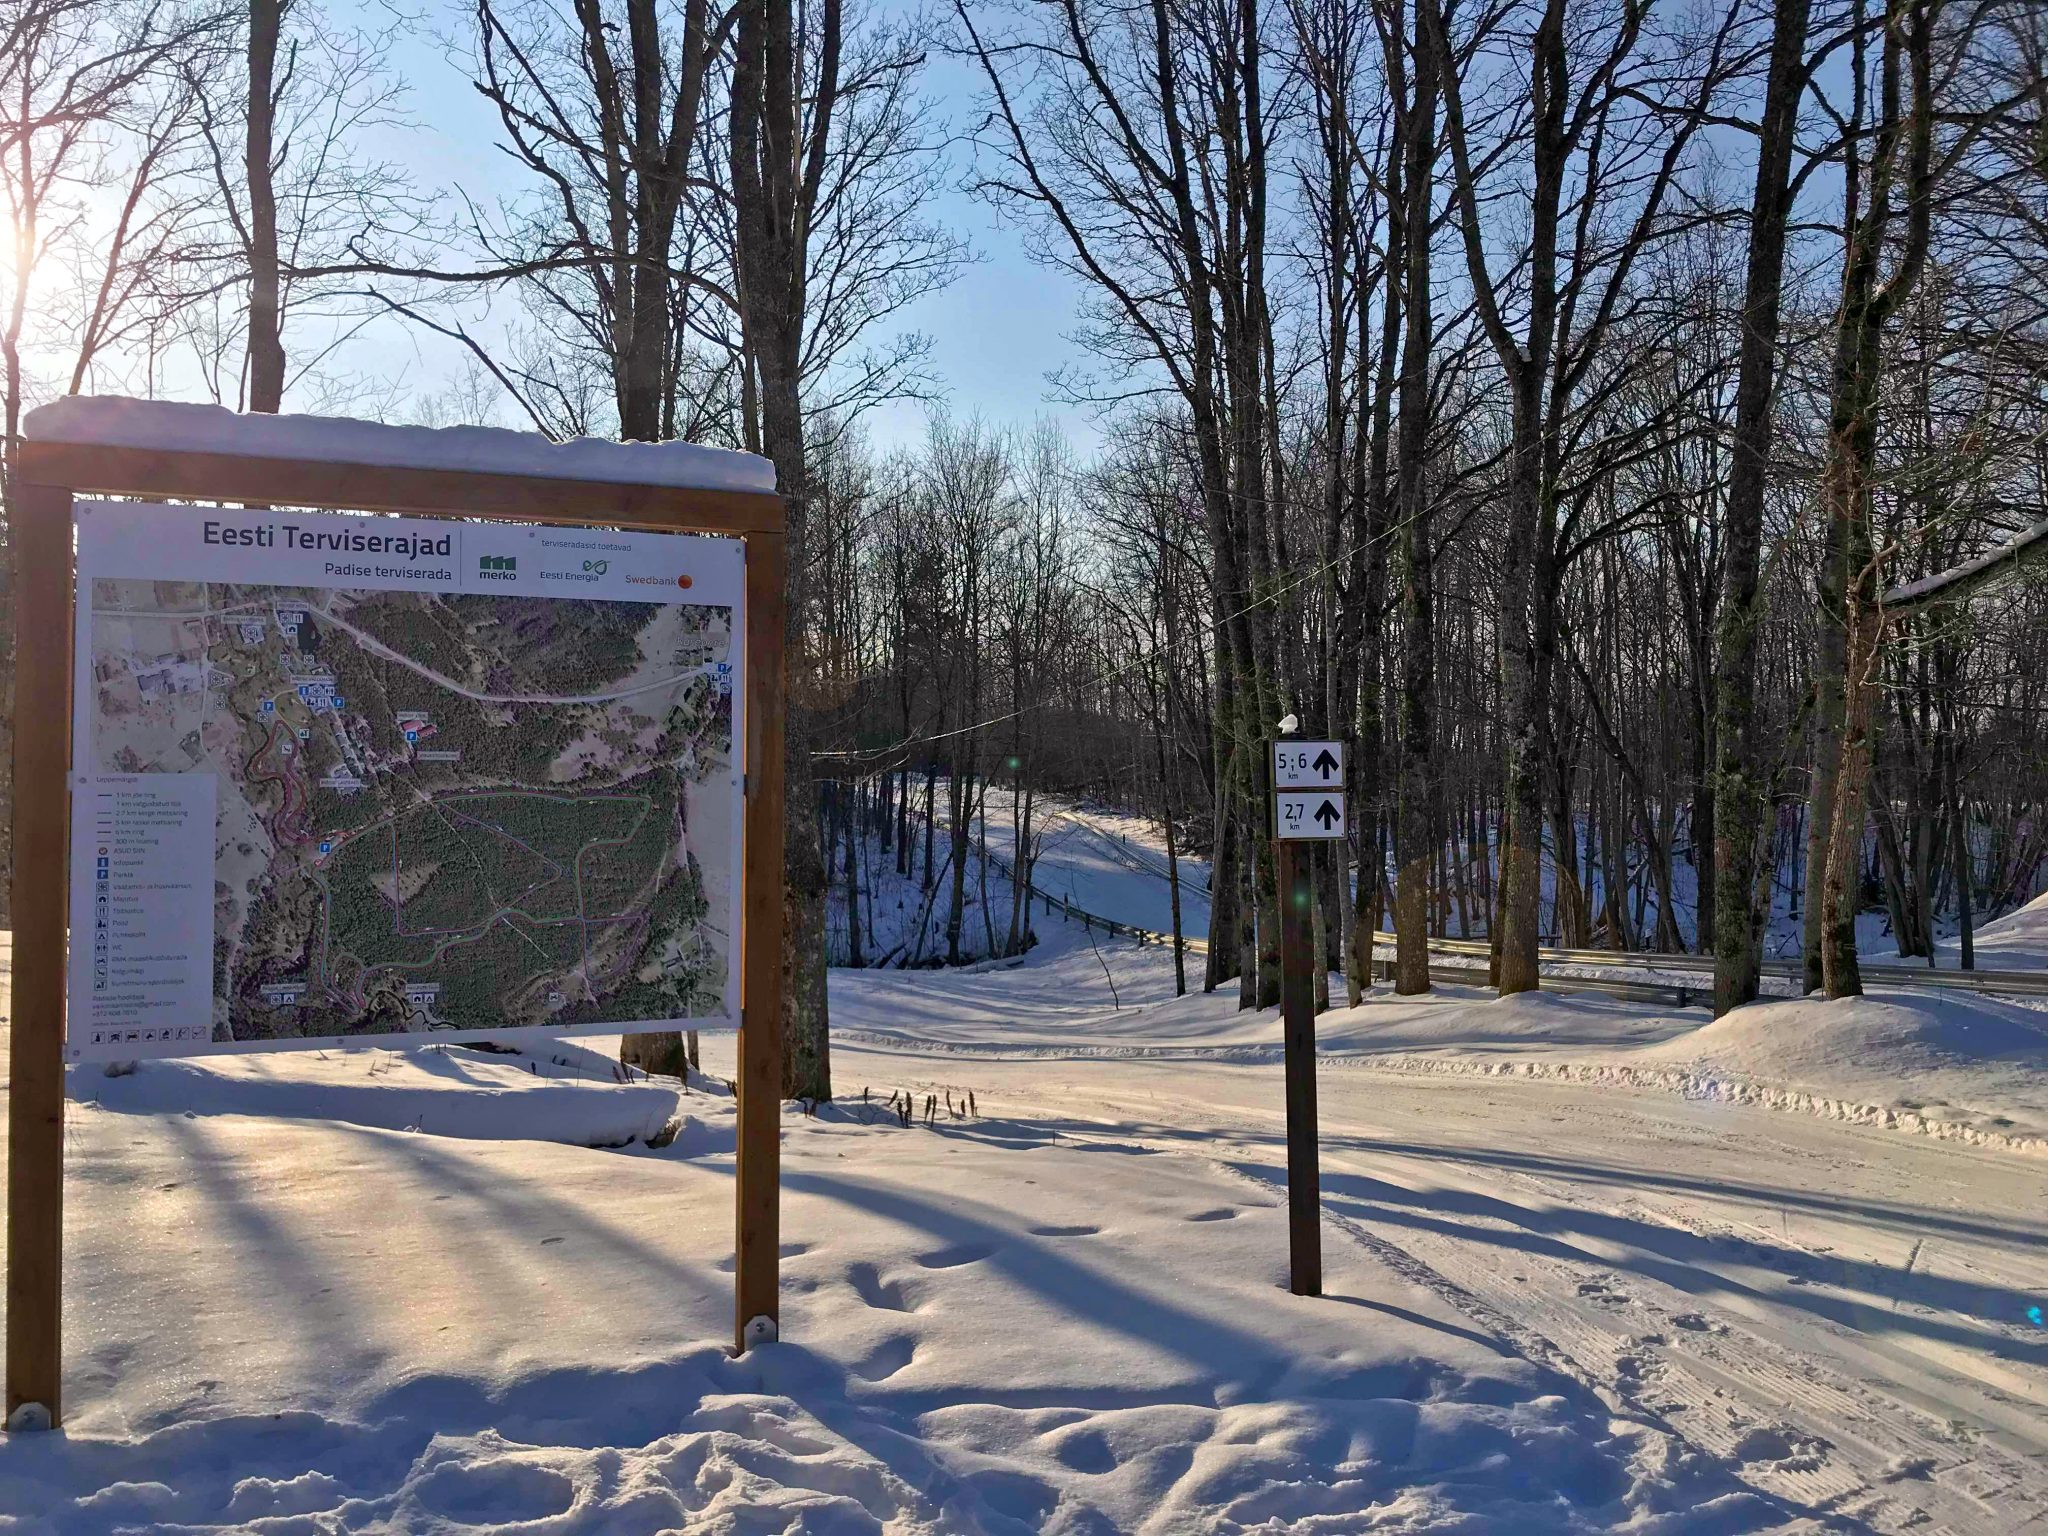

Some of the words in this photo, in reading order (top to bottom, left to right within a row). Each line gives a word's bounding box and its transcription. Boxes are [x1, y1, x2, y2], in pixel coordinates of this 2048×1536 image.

[204, 521, 273, 548] Eesti
[282, 525, 451, 561] Terviserajad
[541, 539, 597, 551] terviseradasid
[598, 542, 632, 552] toetavad
[325, 562, 372, 577] Padise
[375, 565, 452, 581] terviserada
[479, 571, 517, 581] merko
[540, 571, 564, 580] Eesti
[565, 572, 600, 583] Energia
[625, 574, 677, 586] Swedbank
[1288, 772, 1299, 780] km
[1284, 803, 1304, 822] 2,7
[1289, 823, 1301, 831] km
